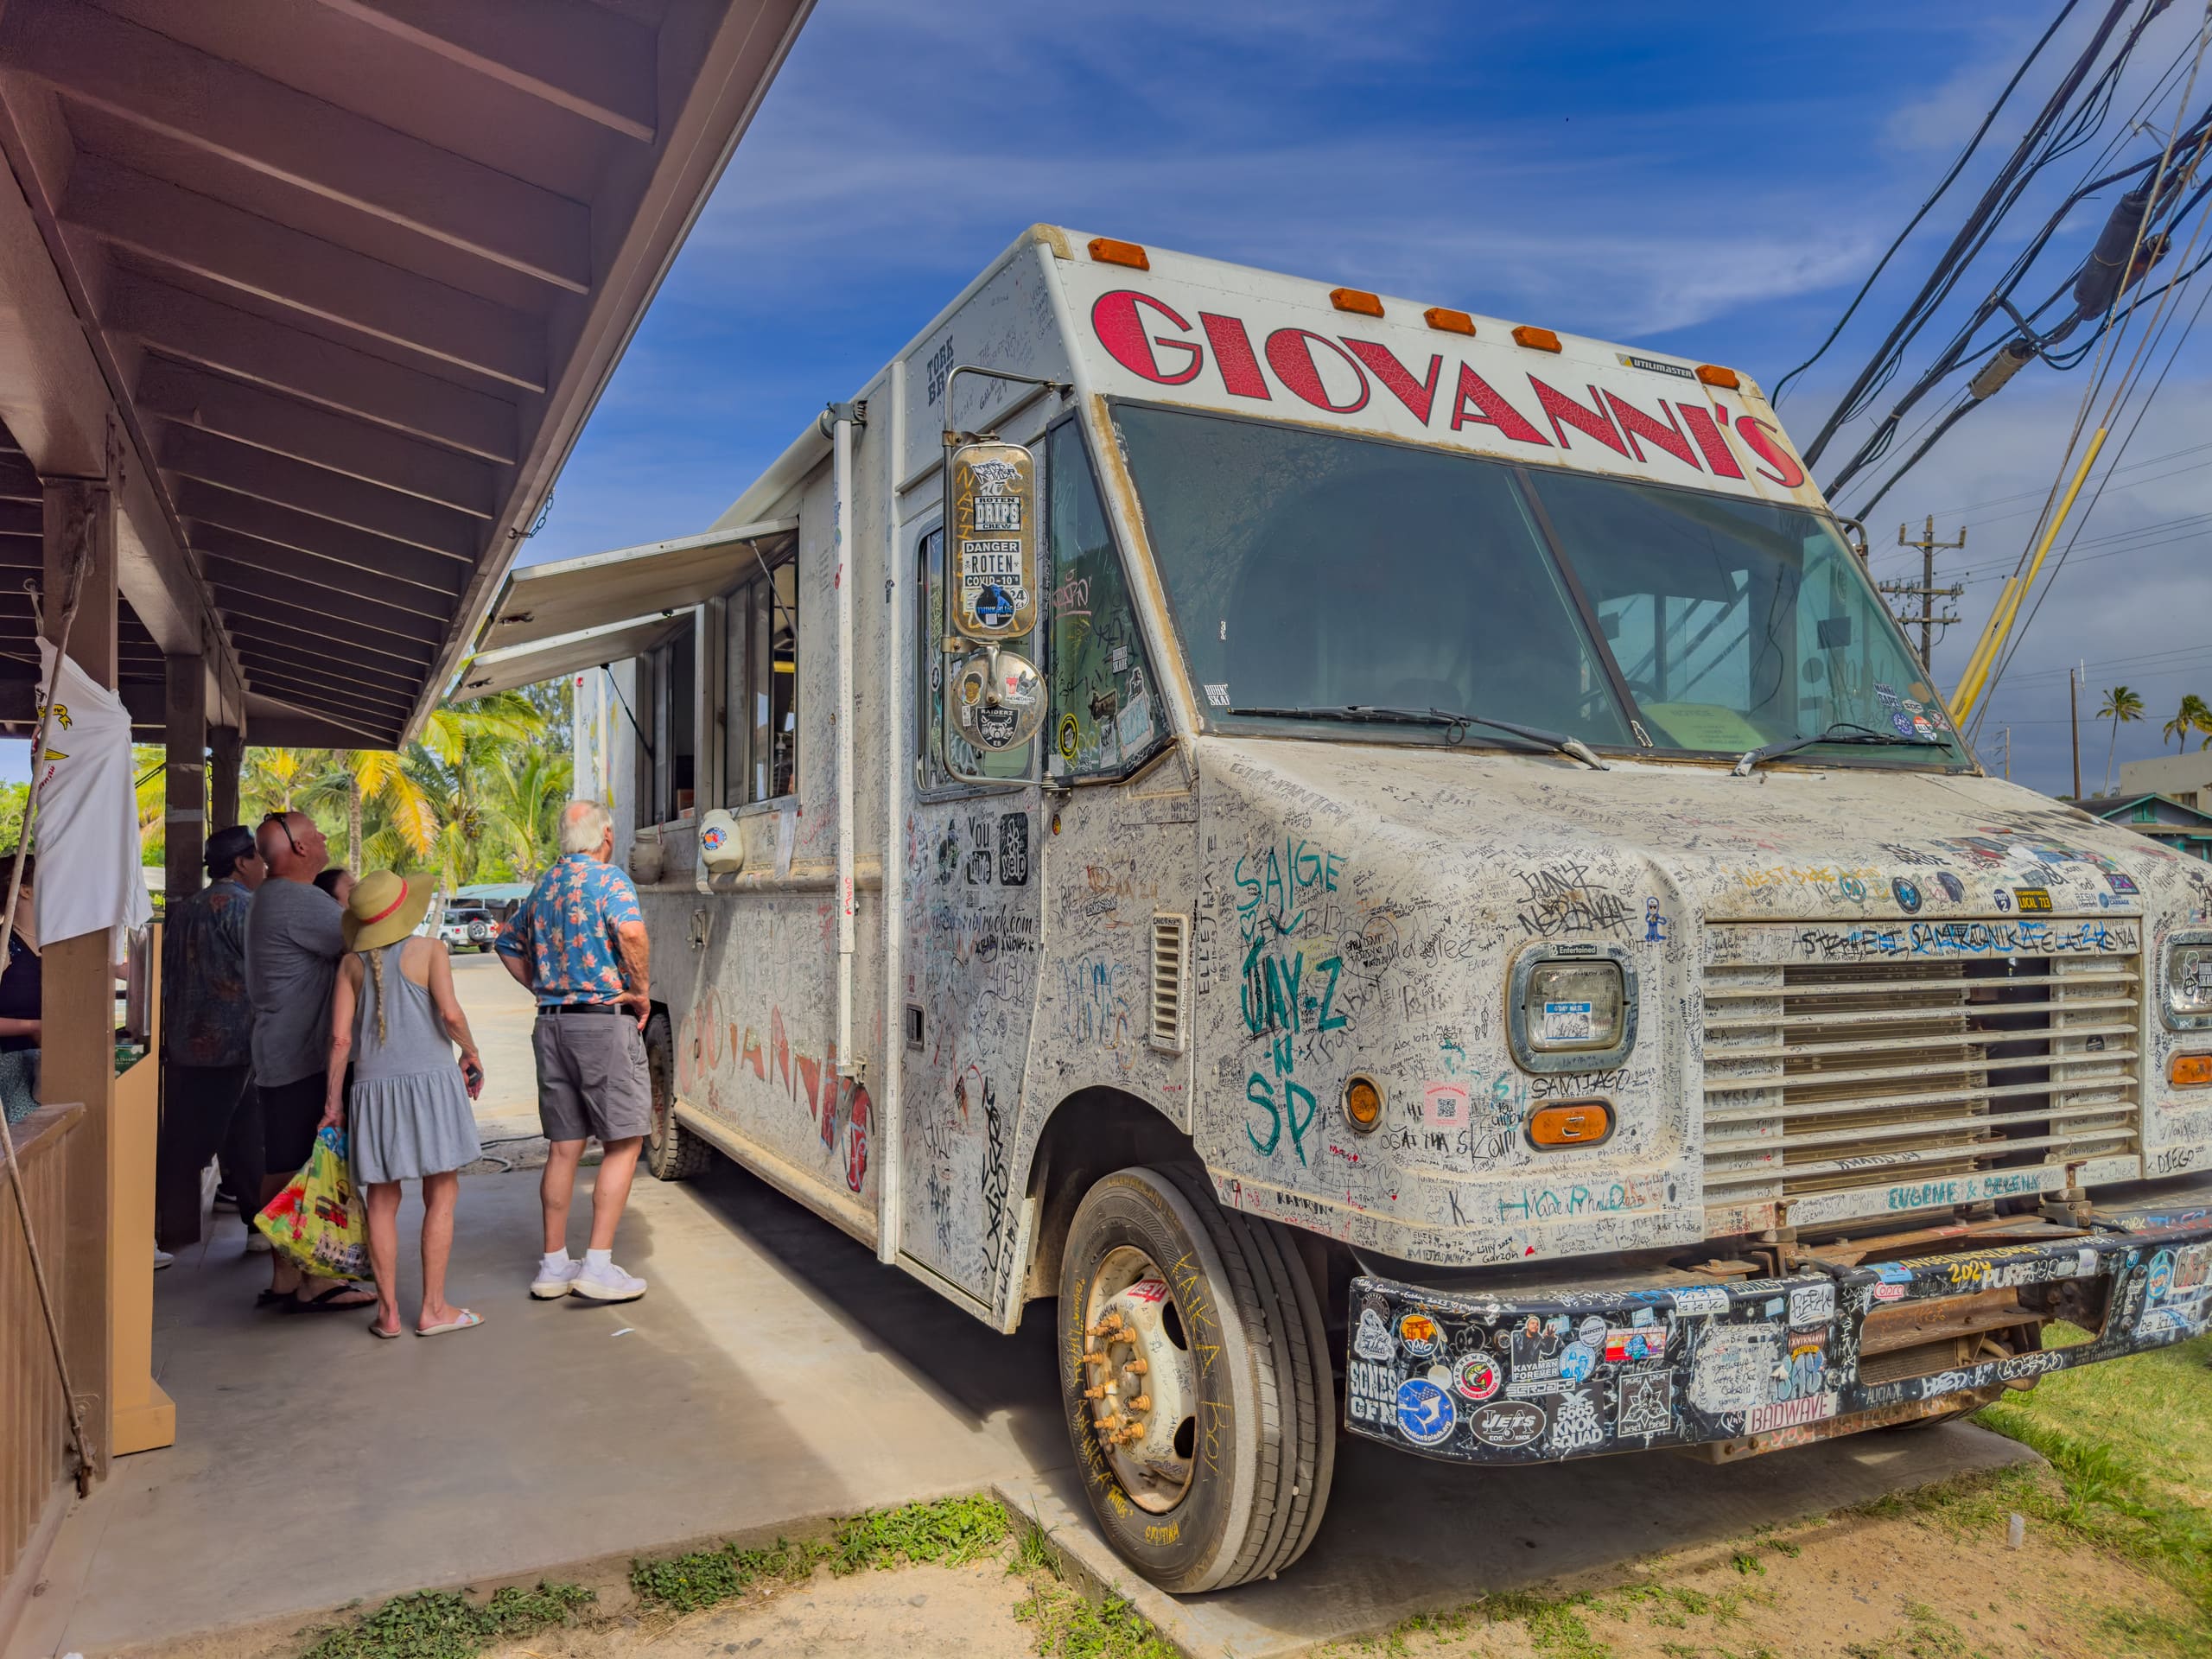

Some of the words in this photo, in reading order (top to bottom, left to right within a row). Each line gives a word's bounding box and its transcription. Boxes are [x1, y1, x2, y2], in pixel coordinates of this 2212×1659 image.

[1634, 359, 1693, 378] UTILIMASTER
[1090, 288, 1806, 489] GIOVANNI'S
[976, 503, 1020, 524] DRIPS
[965, 542, 1018, 553] DANGER
[971, 555, 1013, 574] ROTEN
[1001, 855, 1027, 882] yelp
[2018, 896, 2037, 909] LOCAL
[2039, 896, 2051, 909] 713
[1559, 945, 1597, 955] Entertained
[2157, 1147, 2196, 1174] DIEGO
[1482, 1252, 1519, 1264] Garzon
[2139, 1319, 2152, 1333] be
[1513, 1359, 1559, 1372] KAYAMAN
[1513, 1368, 1559, 1380] FOREVER
[1350, 1360, 1398, 1403] SONES
[1557, 1400, 1594, 1422] 5665
[1751, 1393, 1829, 1432] BADWAVE
[1481, 1414, 1536, 1428] JETS
[1553, 1413, 1599, 1439] KNOK
[1552, 1427, 1604, 1449] SQUAD
